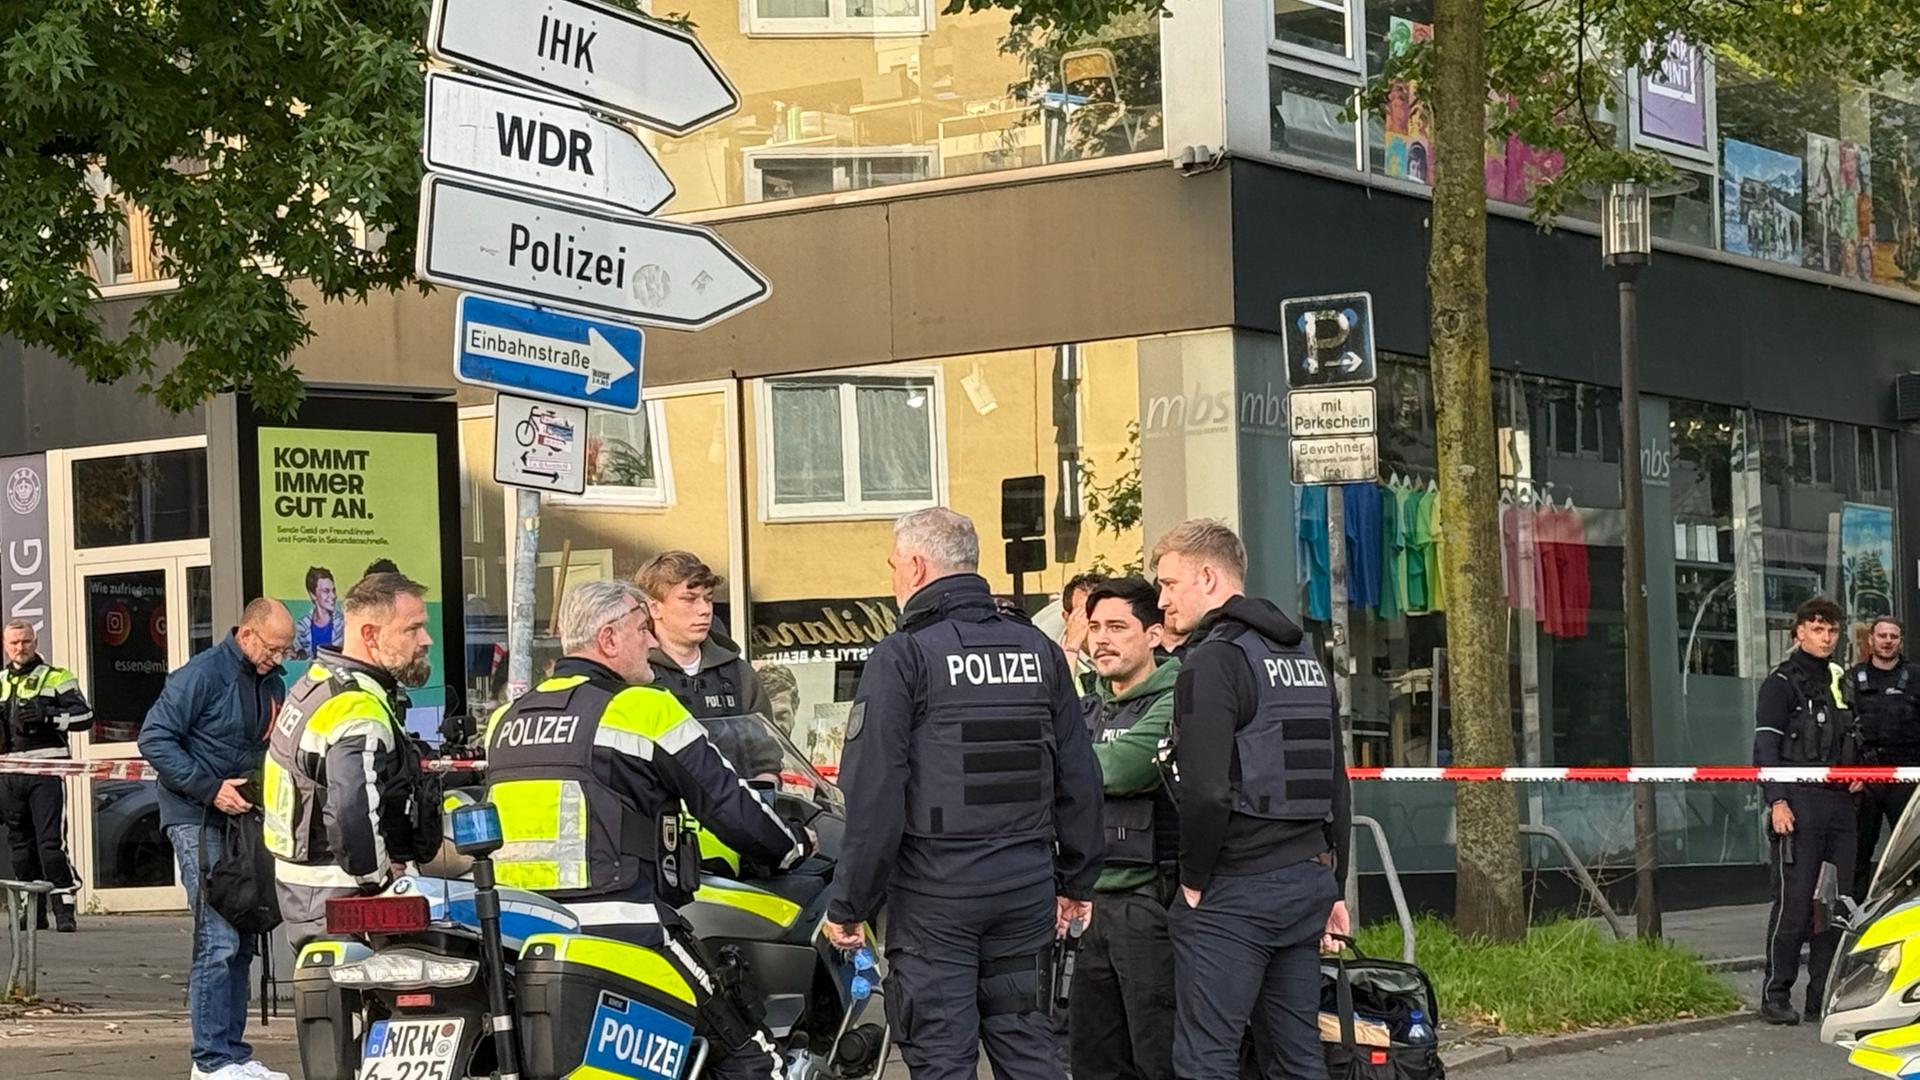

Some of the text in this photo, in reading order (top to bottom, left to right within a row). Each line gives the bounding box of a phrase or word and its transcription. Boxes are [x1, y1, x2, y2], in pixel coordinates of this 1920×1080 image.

[537, 15, 598, 74] IHK
[496, 111, 595, 175] WDR
[508, 223, 626, 288] Polizei
[471, 329, 591, 369] Einbahnstraße
[1305, 309, 1349, 375] P
[1146, 382, 1231, 429] mbs
[1295, 410, 1370, 430] Parkschein
[1322, 396, 1342, 412] mit
[274, 447, 370, 471] KOMMT
[1300, 442, 1366, 455] Bewohner
[1324, 466, 1347, 479] frei
[275, 496, 374, 520] GUT AN.
[10, 538, 44, 648] NG
[91, 582, 109, 594] Wie
[946, 653, 1043, 686] POLIZEI
[1264, 658, 1328, 687] POLIZEI
[496, 716, 580, 748] POLIZEI
[371, 1045, 379, 1054] D
[382, 1025, 440, 1057] NRW
[598, 1017, 684, 1079] POLIZEI
